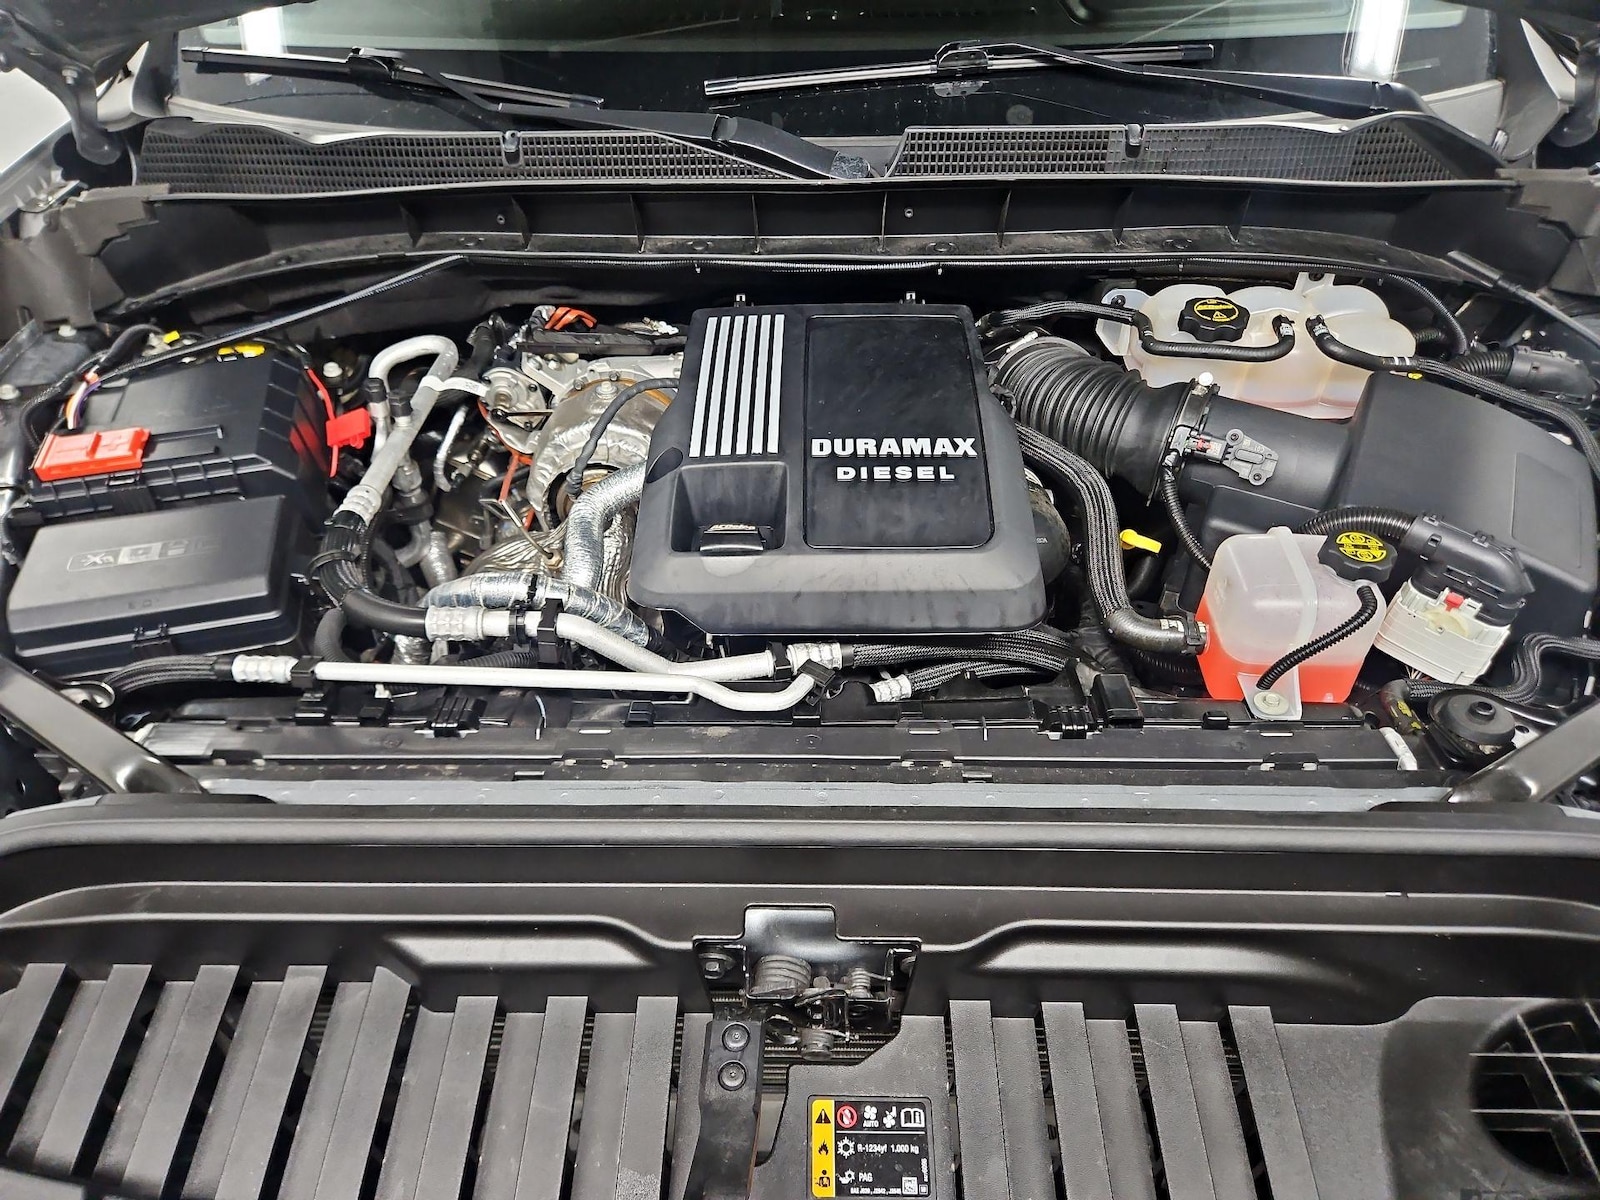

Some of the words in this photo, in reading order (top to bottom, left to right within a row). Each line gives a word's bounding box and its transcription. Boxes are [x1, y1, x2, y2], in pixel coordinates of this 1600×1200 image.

[811, 437, 978, 457] DURAMAX
[836, 466, 955, 480] DIESEL
[863, 1120, 879, 1128] AUTO
[857, 1144, 888, 1154] R-1234yf
[891, 1144, 909, 1153] 1.000
[910, 1144, 919, 1154] kg
[858, 1172, 873, 1182] PAG
